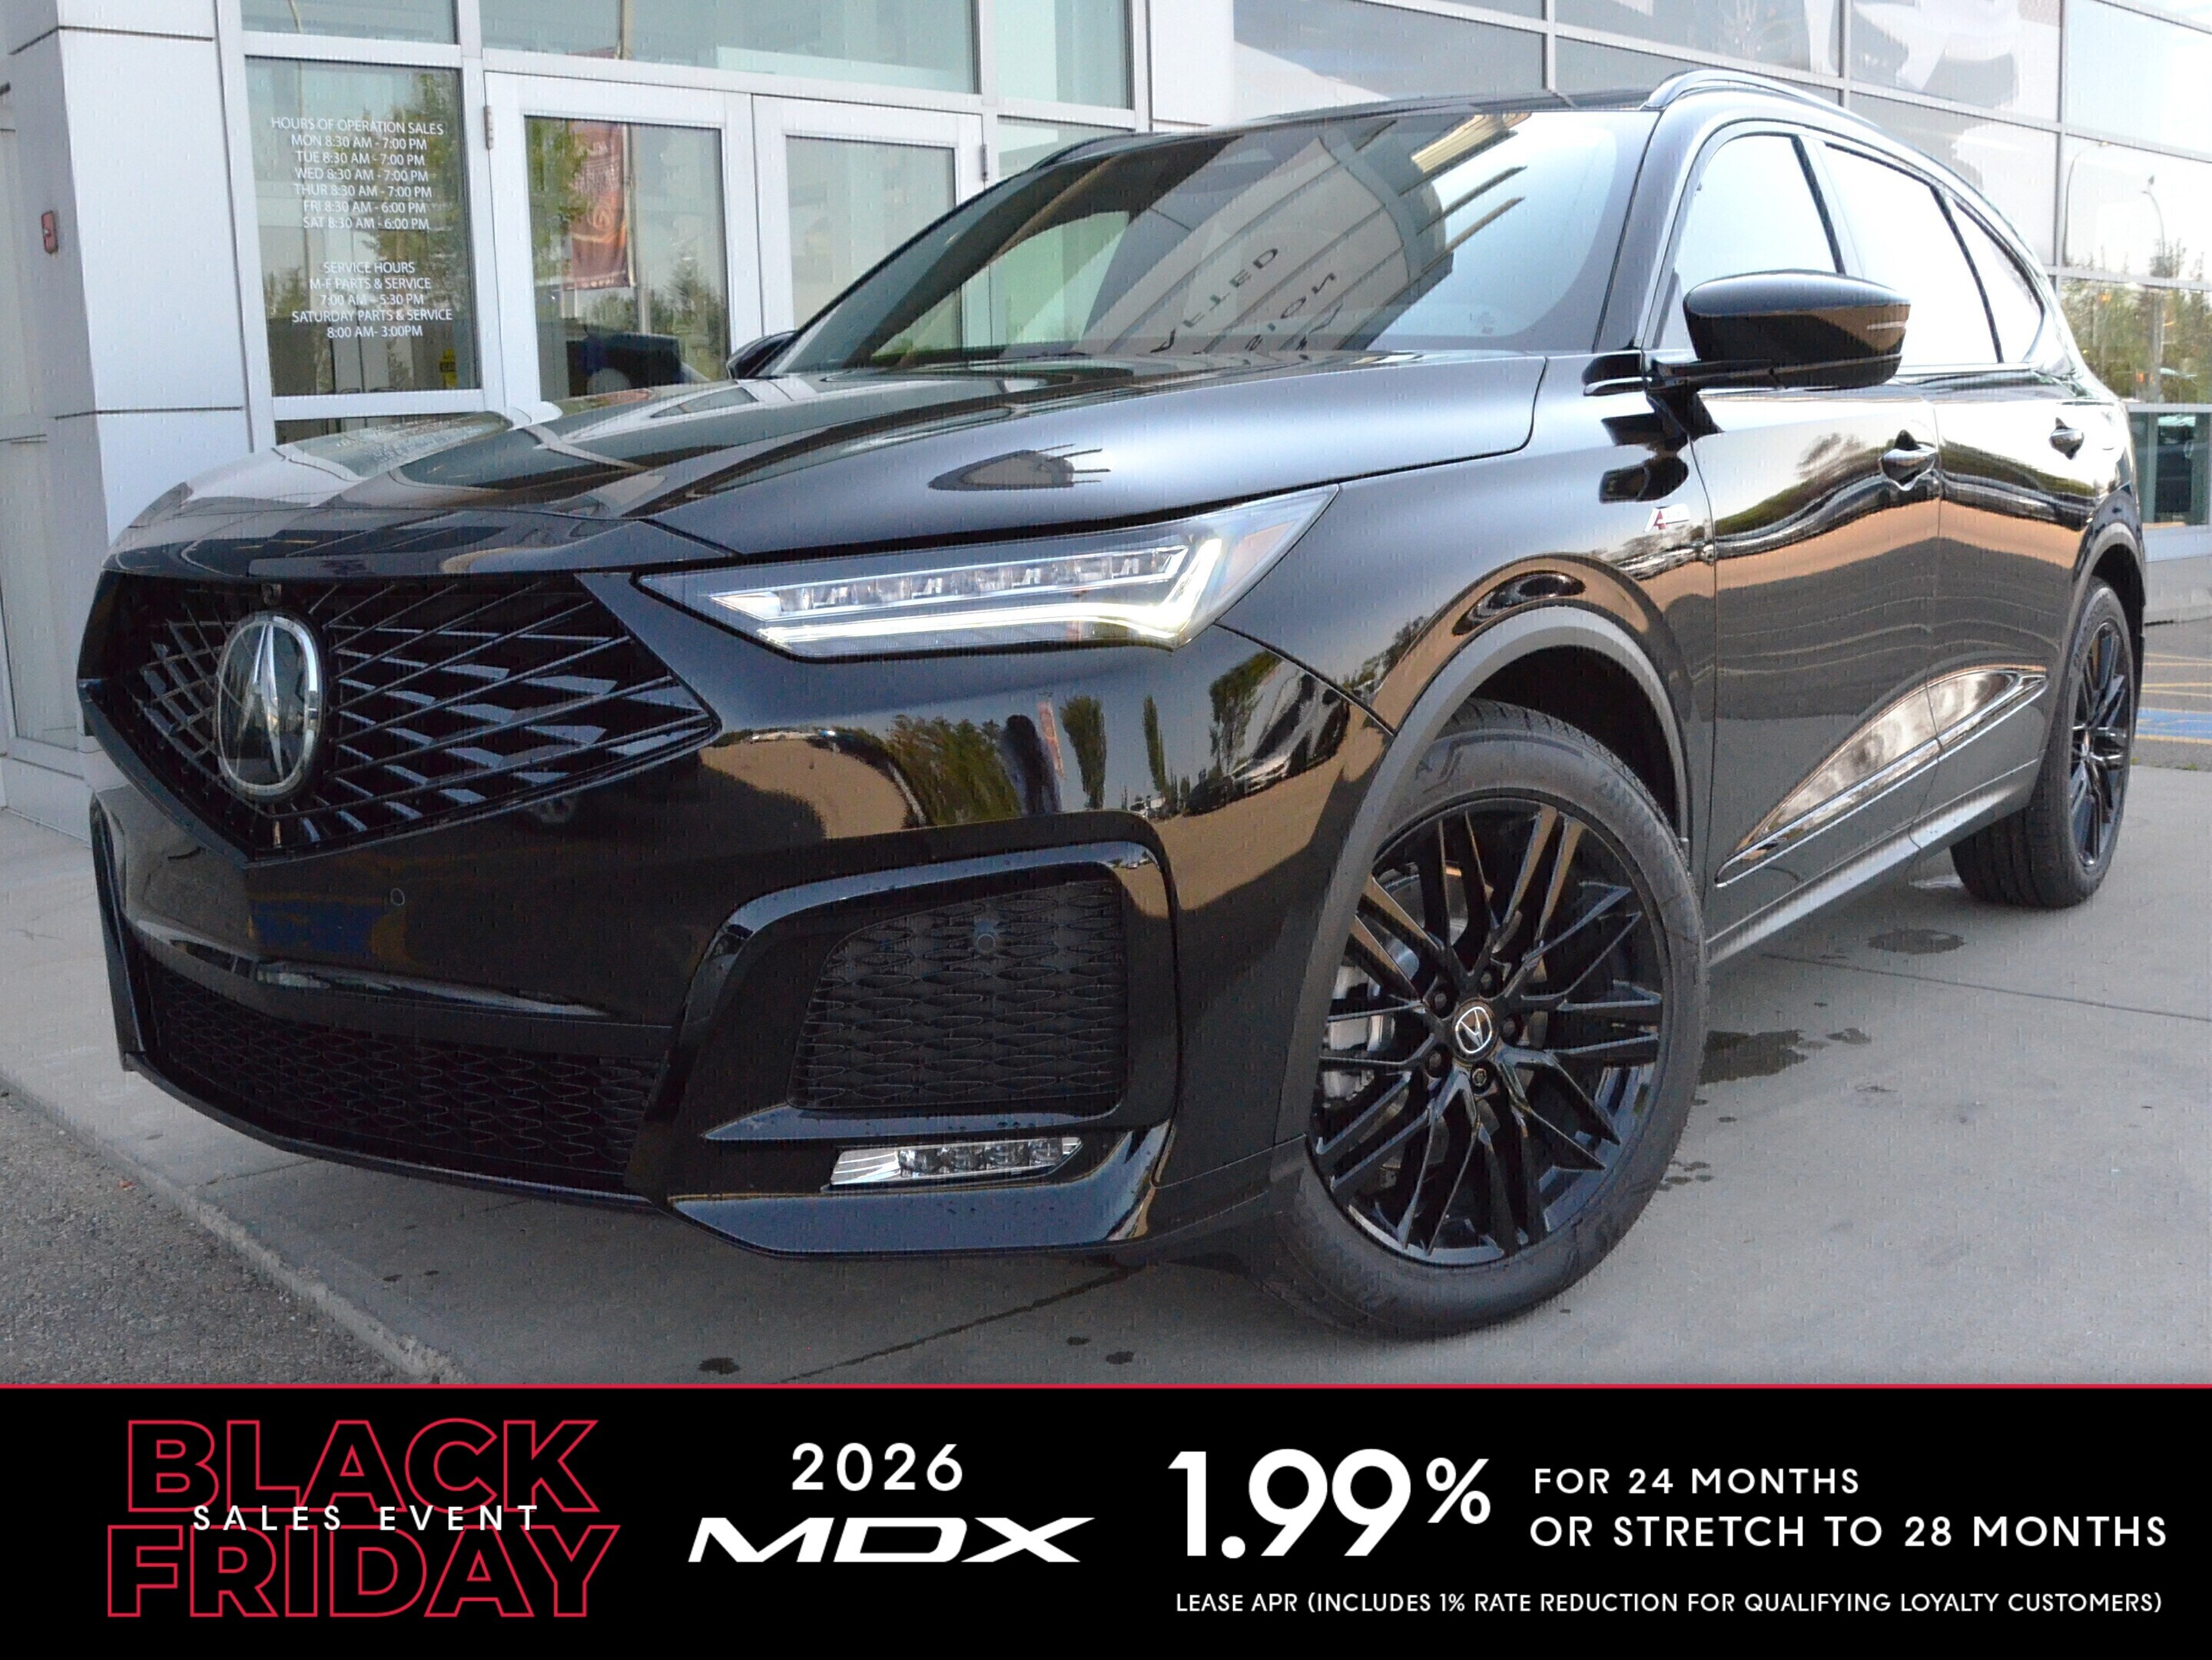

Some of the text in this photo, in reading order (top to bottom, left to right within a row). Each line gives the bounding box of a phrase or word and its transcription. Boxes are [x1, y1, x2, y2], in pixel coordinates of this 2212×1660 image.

[271, 117, 444, 135] HOURS OF OPERATION SALES
[291, 134, 322, 146] MON
[325, 135, 350, 147] 8:30
[353, 137, 373, 148] AM
[383, 138, 406, 149] 7:00
[409, 138, 427, 151] PM
[295, 151, 320, 162] TUE
[323, 151, 348, 164] 8:30
[351, 152, 370, 164] AM
[380, 154, 404, 165] 7:00
[406, 154, 425, 166] PM
[295, 168, 323, 180] WED
[327, 168, 351, 180] 8:30
[355, 169, 374, 181] AM
[384, 170, 408, 181] 7:00
[411, 171, 429, 182] PM
[293, 184, 328, 196] THUR
[330, 184, 355, 197] 8:30
[358, 185, 378, 197] AM
[387, 186, 412, 198] 7:00
[415, 187, 432, 198] PM
[303, 200, 321, 212] FRI
[324, 201, 349, 212] 8:30
[353, 201, 372, 213] AM
[381, 202, 406, 214] 6:00
[409, 202, 426, 214] PM
[303, 216, 325, 229] SAT
[327, 217, 353, 229] 8:30
[355, 217, 375, 229] AM
[385, 218, 409, 230] 6:00
[411, 218, 429, 230] PM
[323, 261, 415, 274] SERVICE HOURS
[310, 277, 432, 290] M-F PARTS & SERVICE
[320, 294, 345, 306] 7:00
[348, 294, 367, 306] AM
[380, 294, 404, 305] 5:30
[406, 294, 424, 305] PM
[292, 309, 453, 323] SATURDAY PARTS & SERVICE
[327, 327, 352, 339] 8:00
